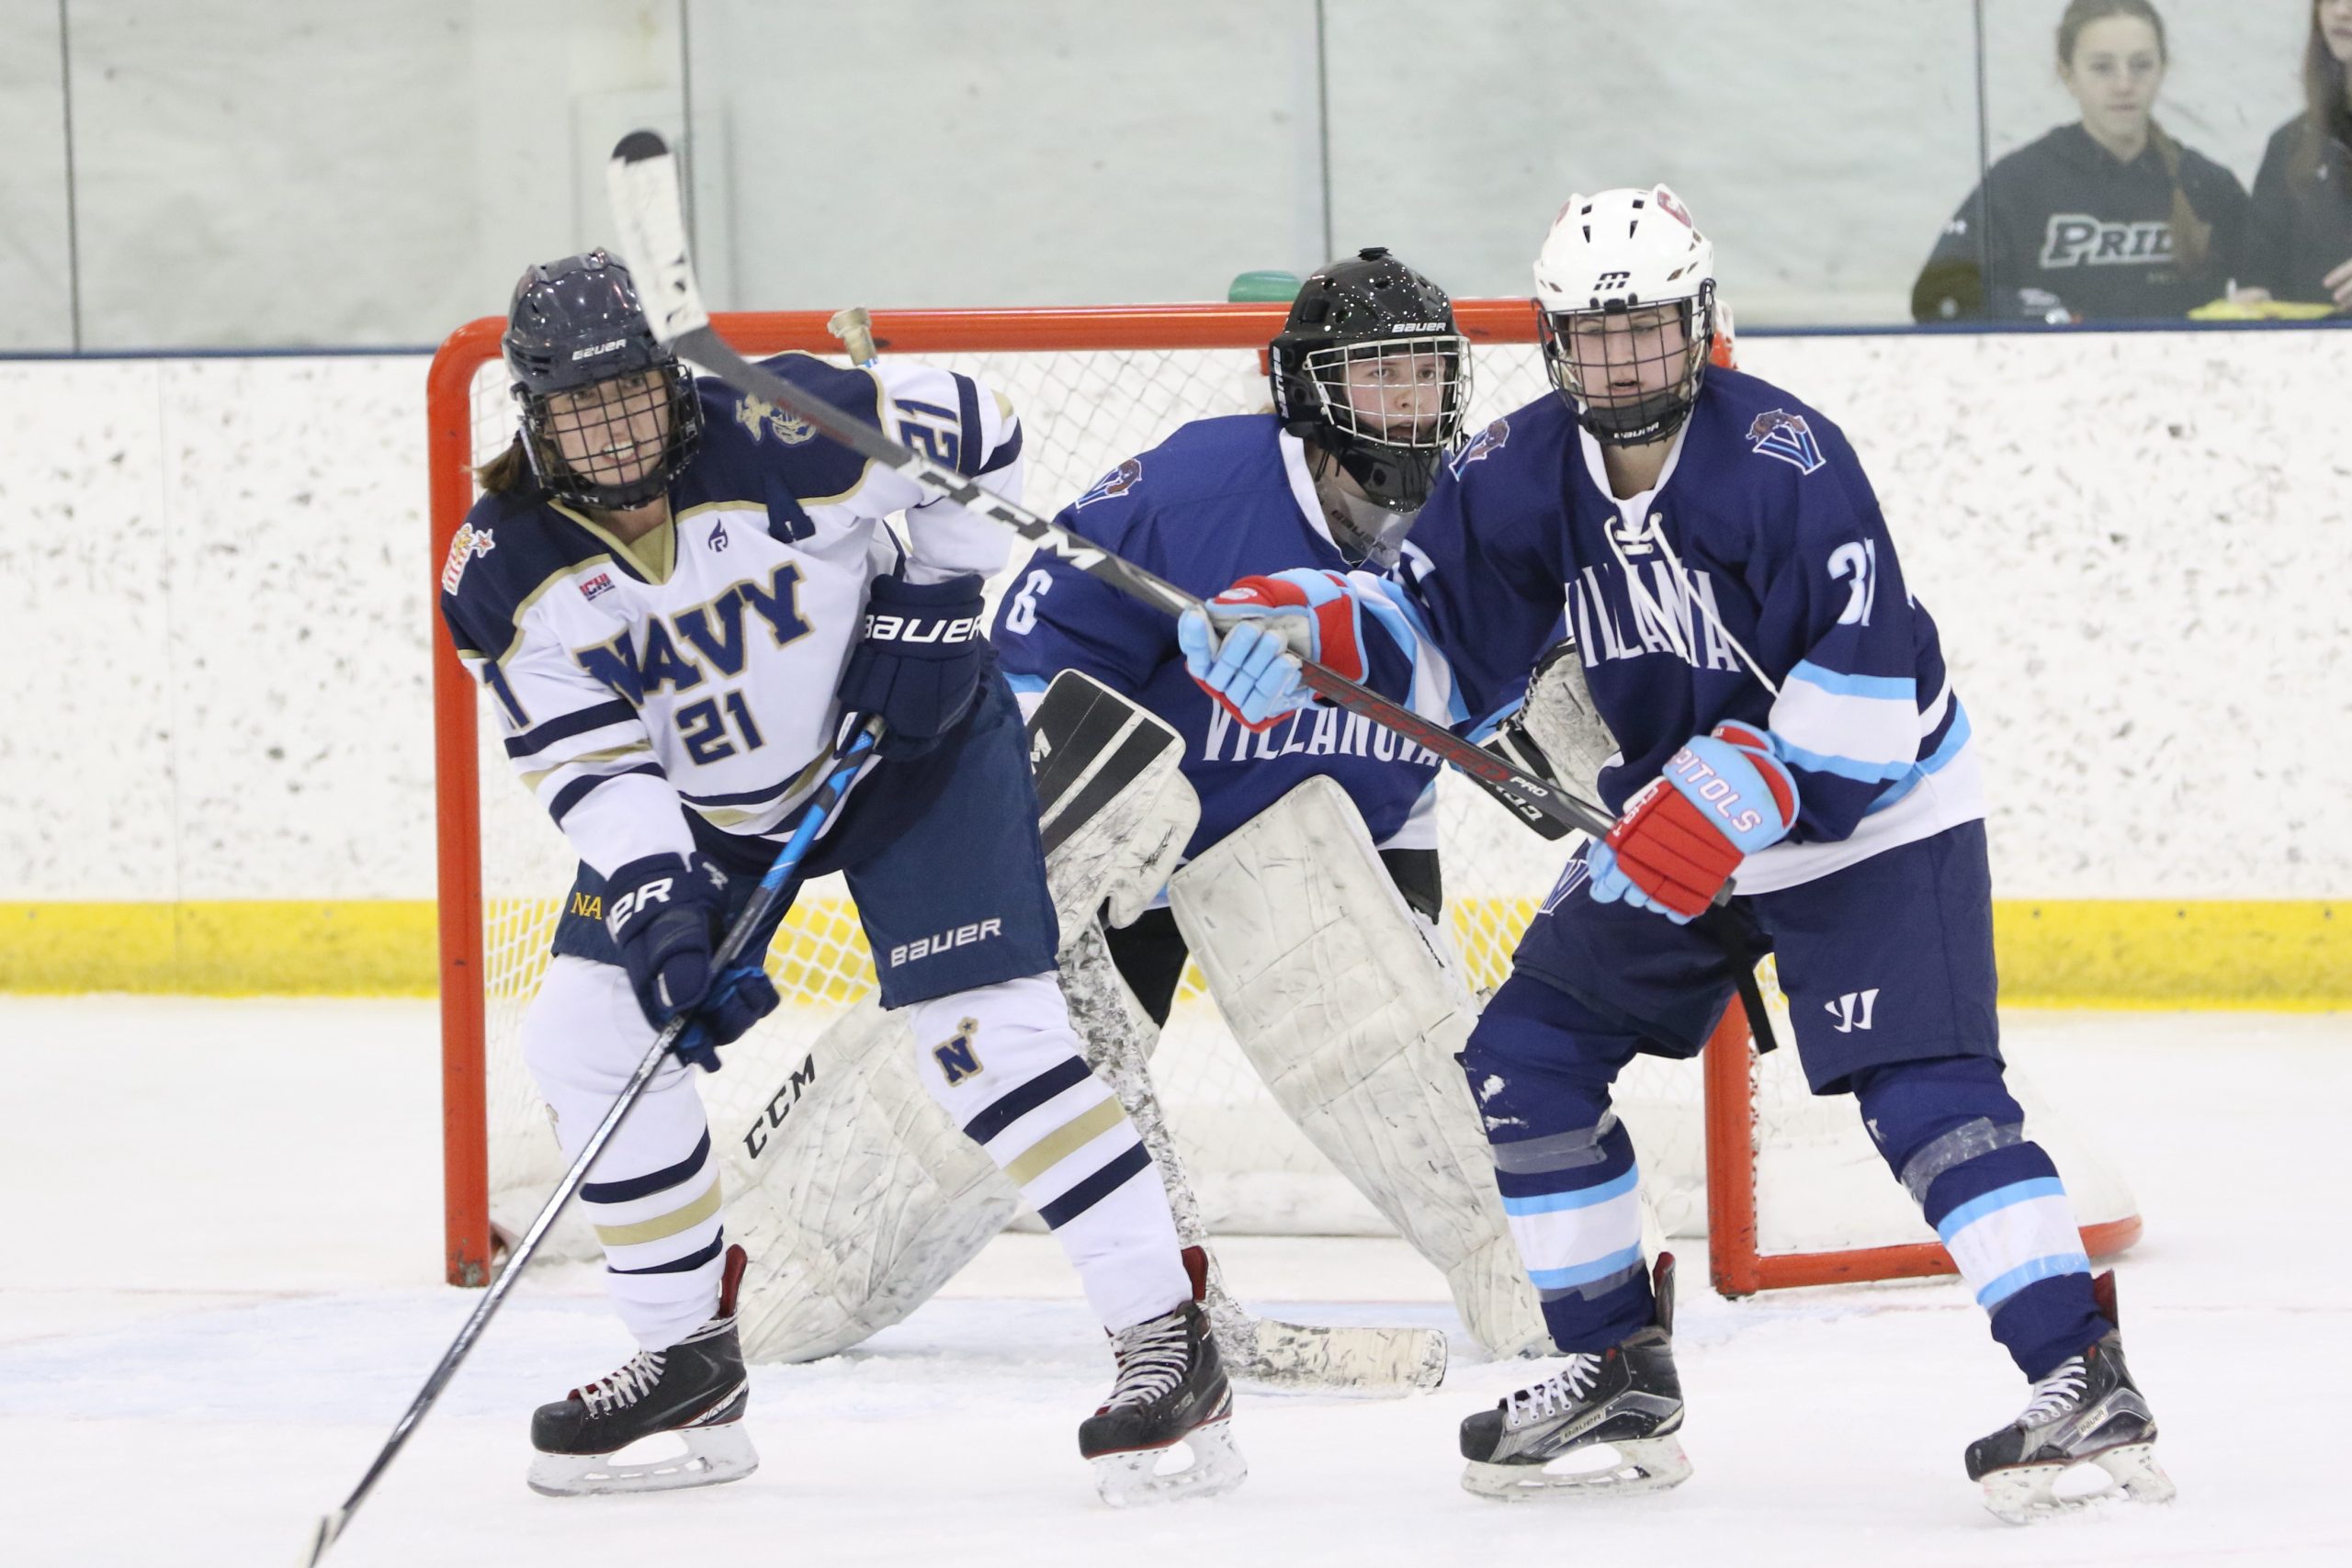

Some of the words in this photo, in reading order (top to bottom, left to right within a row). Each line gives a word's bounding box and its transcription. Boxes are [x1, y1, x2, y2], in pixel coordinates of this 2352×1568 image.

[571, 338, 627, 361] BAUER
[1392, 321, 1446, 333] BAUER
[895, 452, 1107, 570] CCM
[1005, 569, 1054, 634] 6
[571, 559, 815, 709] NAVY
[673, 688, 766, 765] 21
[1510, 776, 1548, 797] PRO
[571, 892, 603, 920] NA
[890, 918, 1002, 969] BAUER
[743, 1054, 816, 1160] CCM
